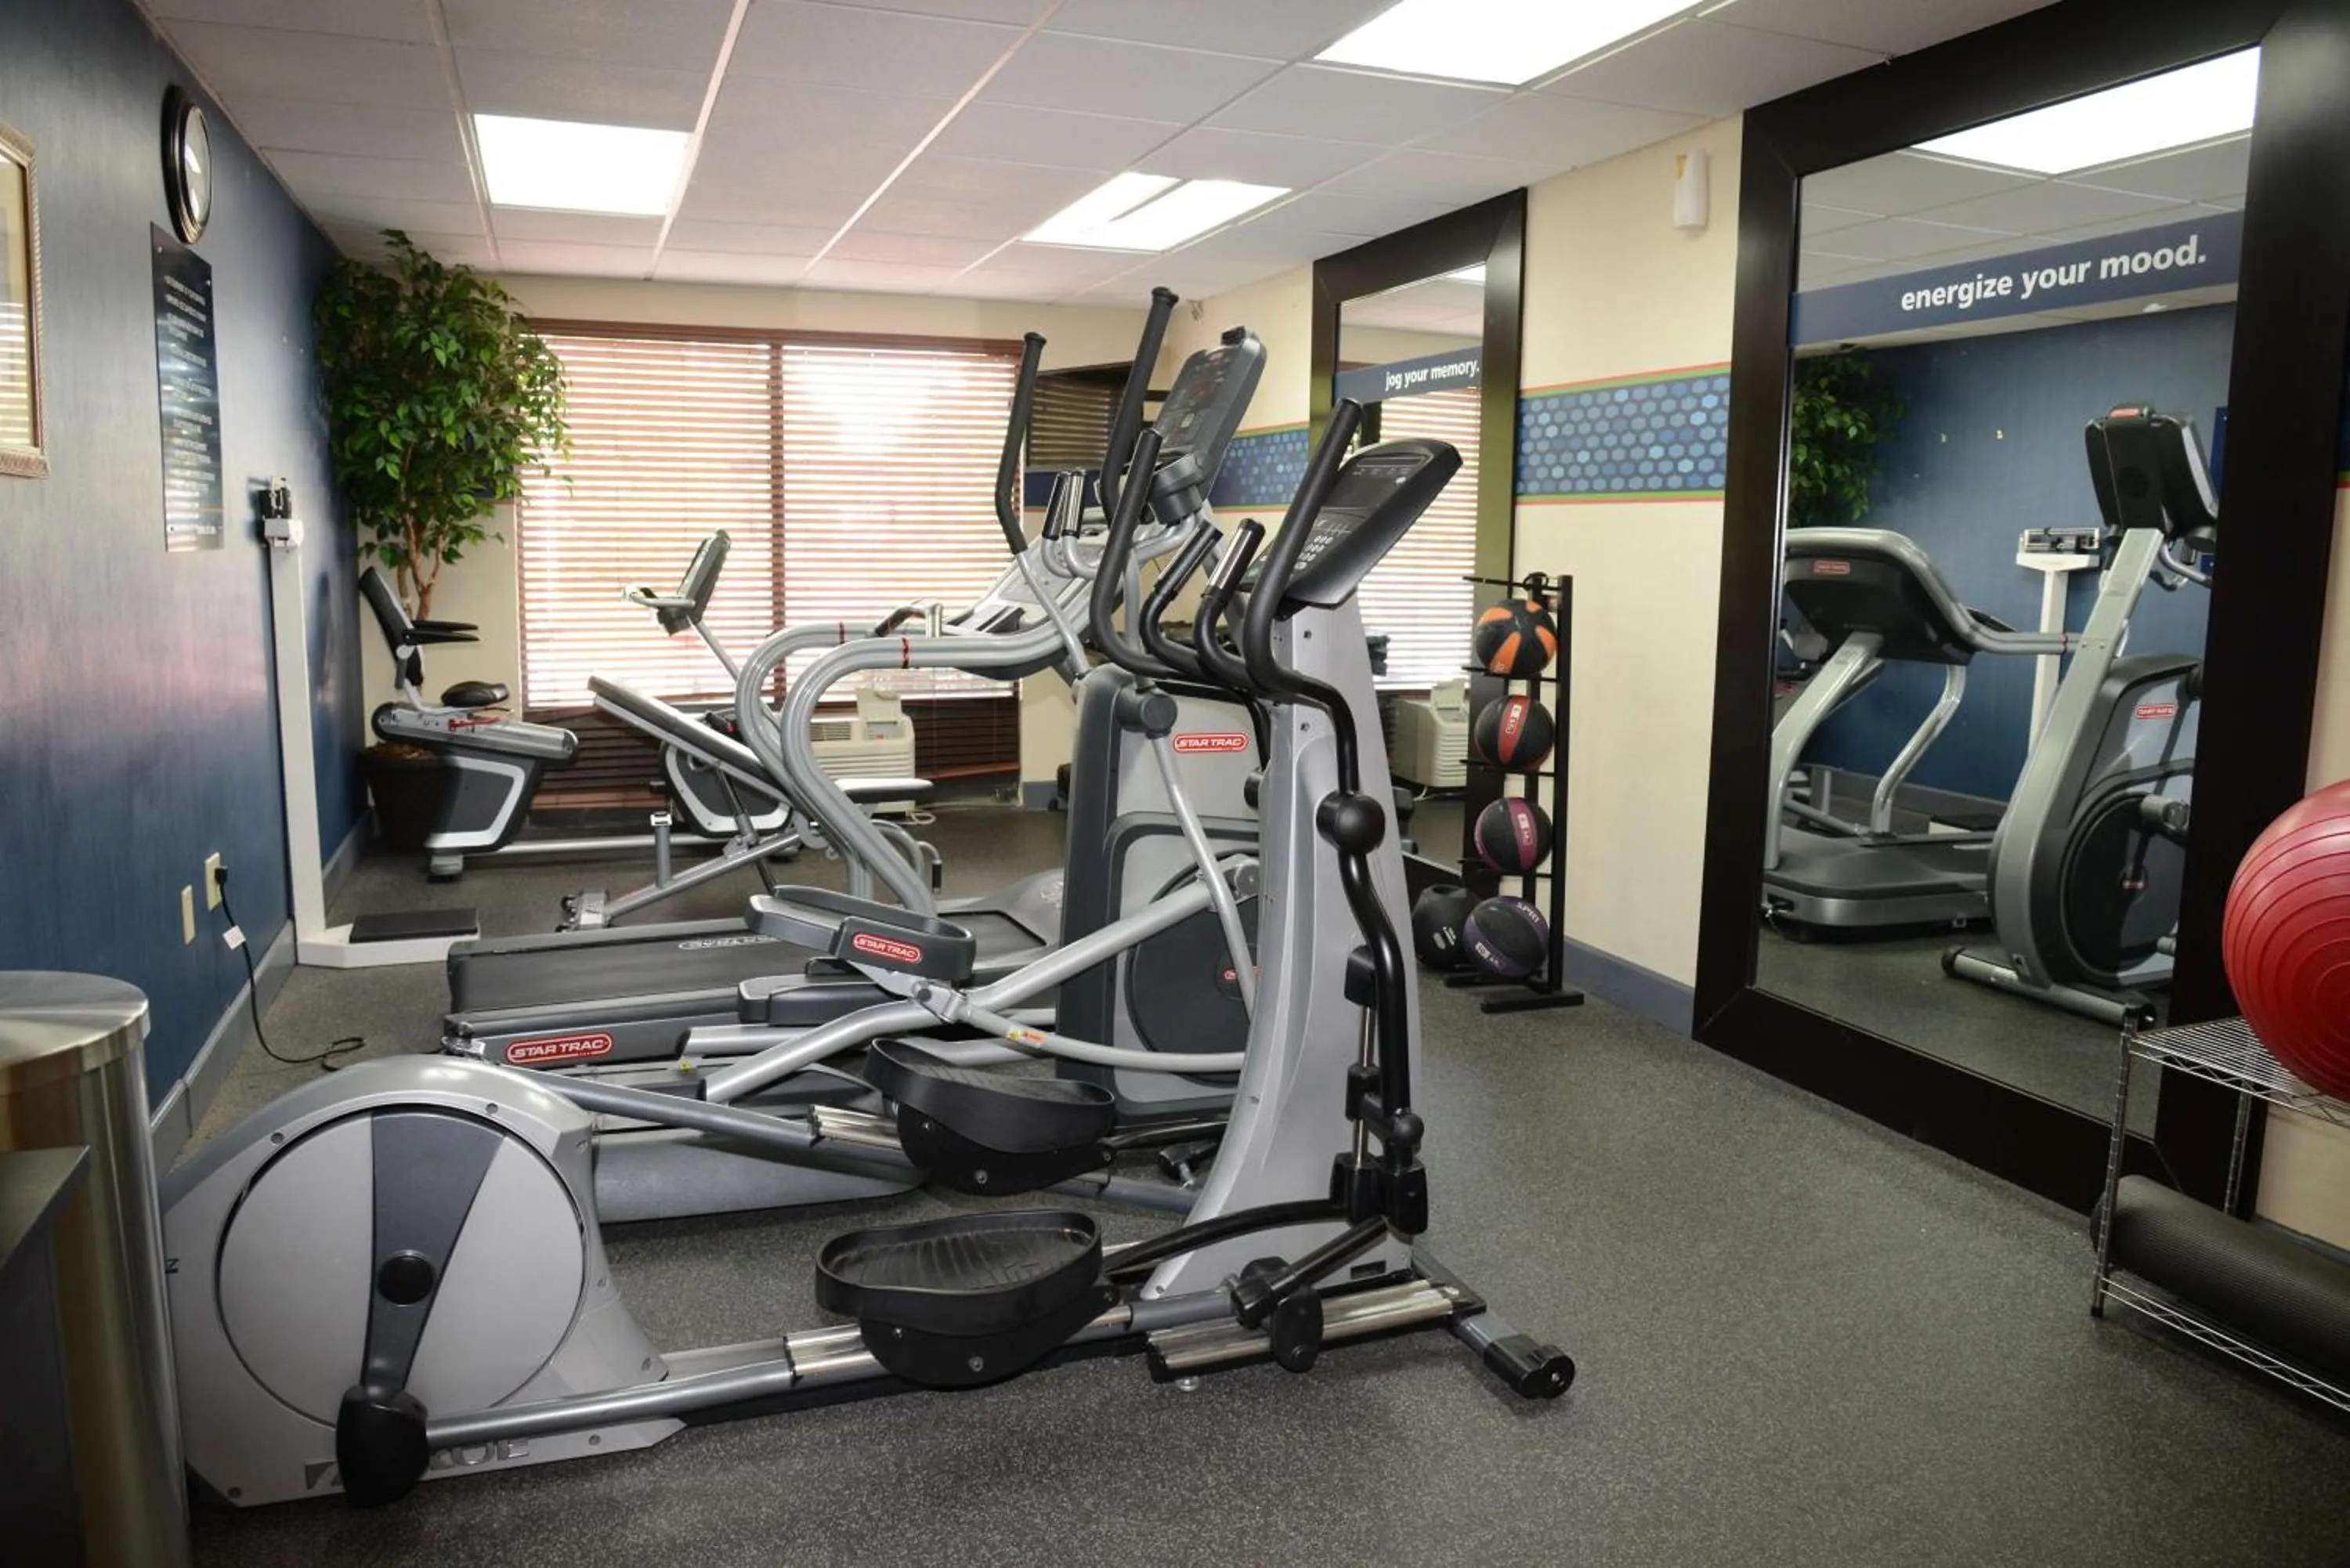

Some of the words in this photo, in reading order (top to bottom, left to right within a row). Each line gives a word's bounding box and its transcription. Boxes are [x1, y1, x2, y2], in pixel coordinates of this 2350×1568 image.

[1900, 273, 2013, 311] energize
[2021, 259, 2090, 300] your
[2099, 234, 2207, 280] mood.
[1385, 371, 1403, 392] jog
[1405, 368, 1429, 388] your
[1430, 359, 1480, 378] memory.
[1178, 739, 1209, 747] STAR
[1210, 738, 1242, 746] TRAC
[858, 938, 886, 951] STAR
[886, 945, 916, 958] TRAC
[514, 1044, 557, 1058] STAR
[559, 1039, 604, 1052] TRAC
